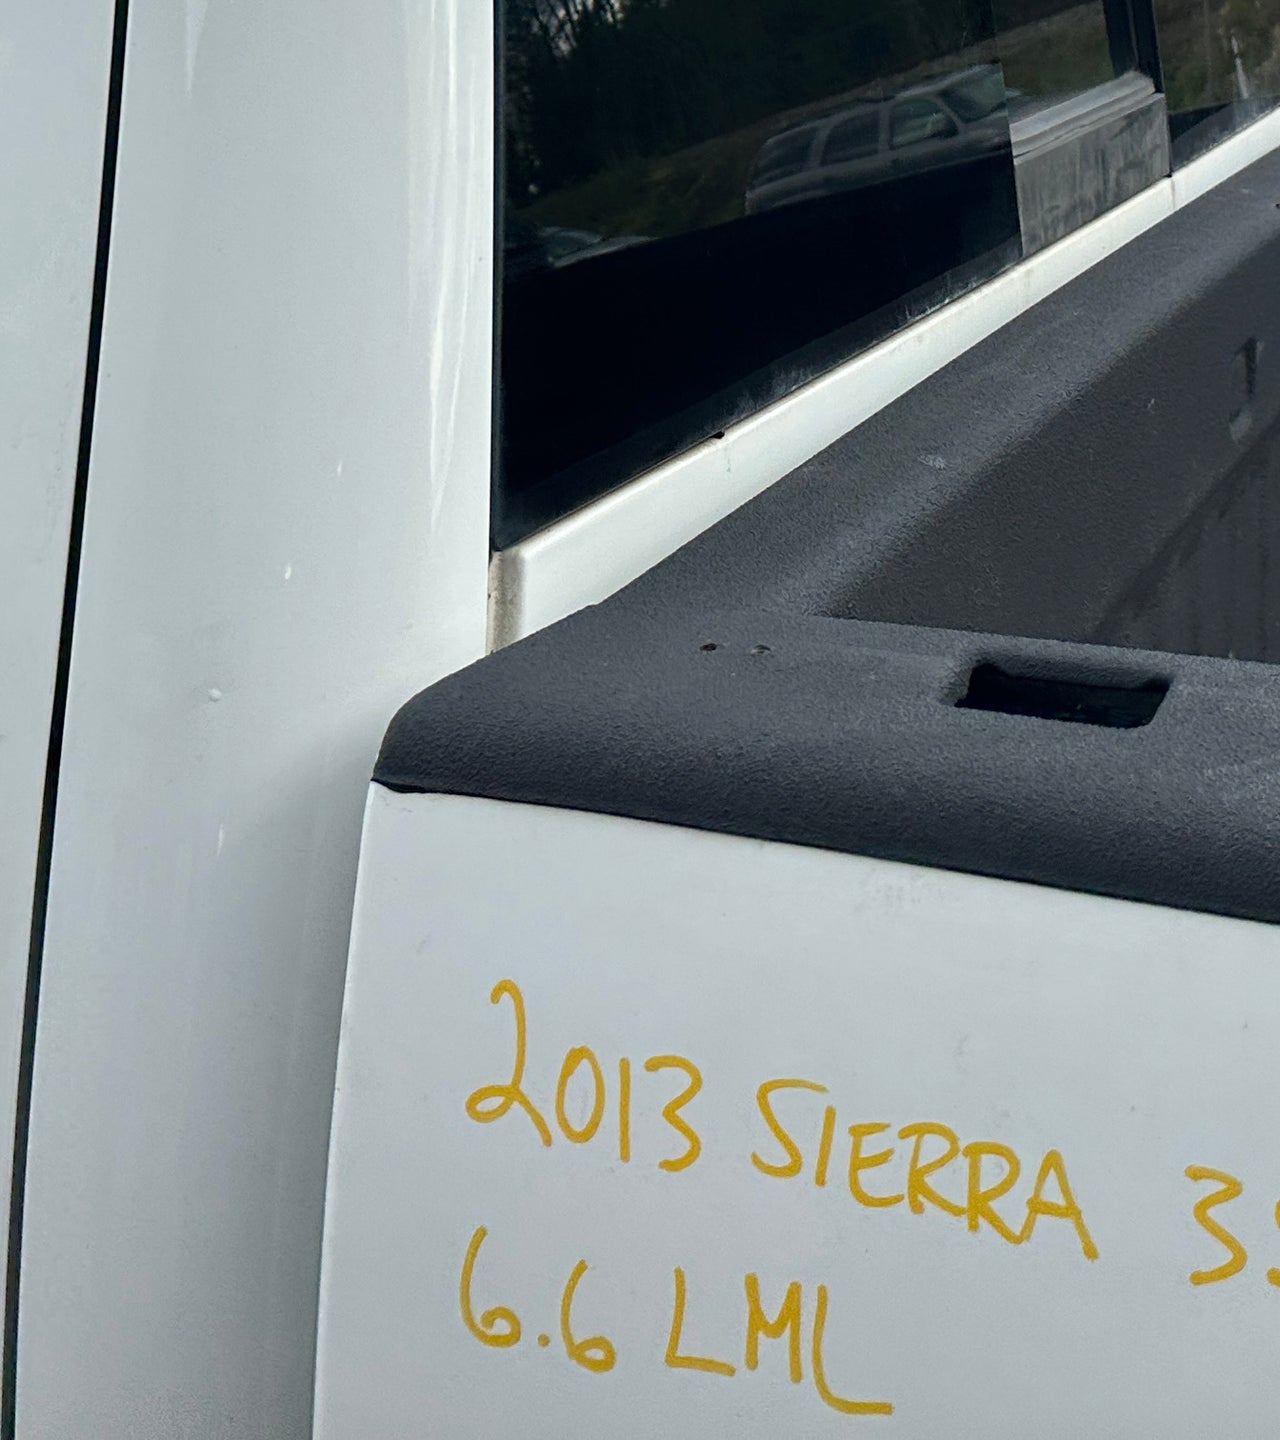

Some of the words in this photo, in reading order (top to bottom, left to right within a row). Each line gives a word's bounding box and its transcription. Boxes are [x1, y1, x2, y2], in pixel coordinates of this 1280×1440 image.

[464, 978, 704, 1173] 2013
[750, 1077, 1100, 1262] SIERRA
[459, 1225, 617, 1374] 6.6
[663, 1266, 894, 1416] LML
